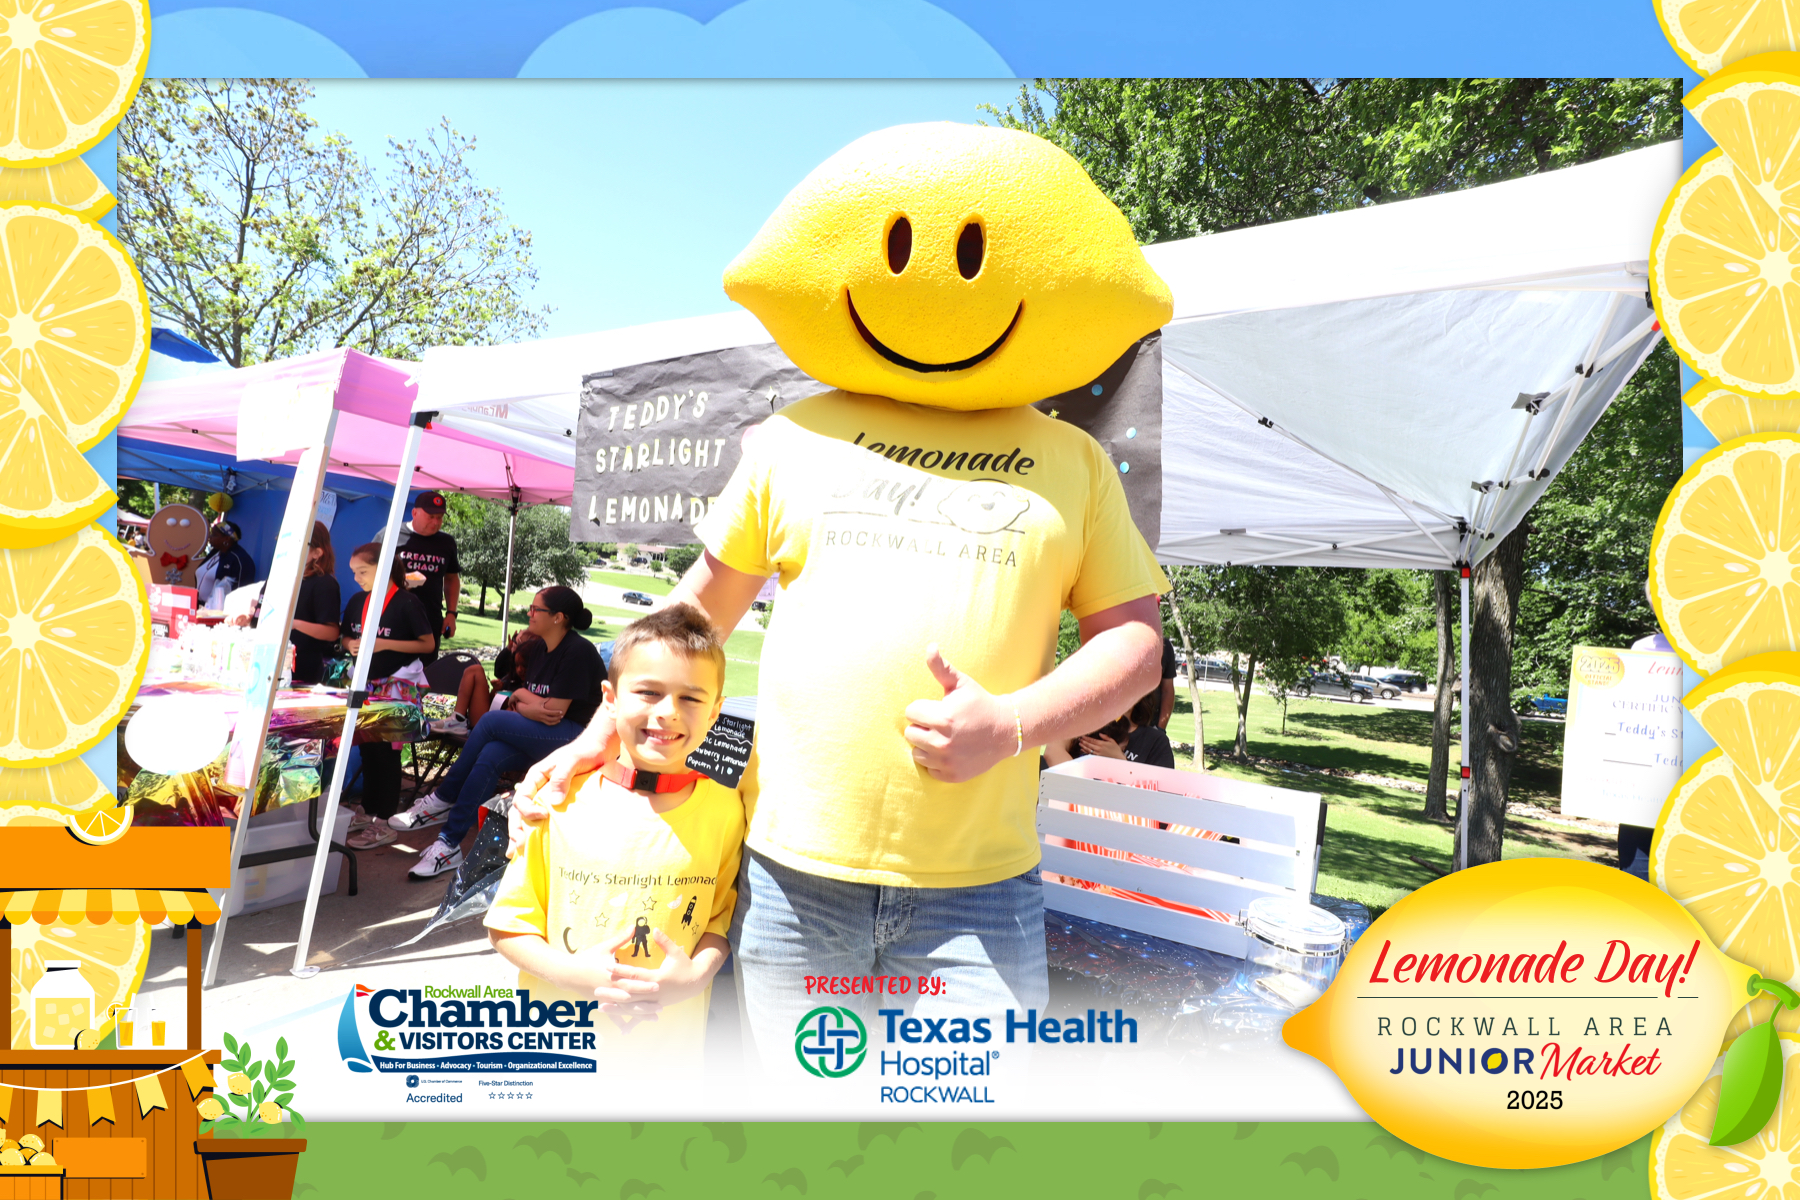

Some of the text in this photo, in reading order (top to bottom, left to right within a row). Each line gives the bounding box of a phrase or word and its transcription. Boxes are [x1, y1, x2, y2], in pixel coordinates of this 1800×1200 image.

[608, 389, 709, 432] TEDDY'S
[595, 438, 726, 474] STARLIGHT
[826, 530, 1017, 567] ROCKWALL AREA
[400, 551, 445, 565] CREATIVE
[407, 561, 439, 572] CHAOS
[1580, 655, 1620, 674] 2025
[1648, 661, 1683, 676] Lem
[714, 724, 746, 739] Lemonade
[722, 717, 752, 733] Starlight
[1617, 721, 1666, 740] Teddy's
[695, 747, 720, 762] awberry
[713, 739, 747, 755] Lemonade
[687, 756, 711, 770] Popcorn
[559, 866, 600, 885] Teddy's
[604, 873, 662, 888] Starlight
